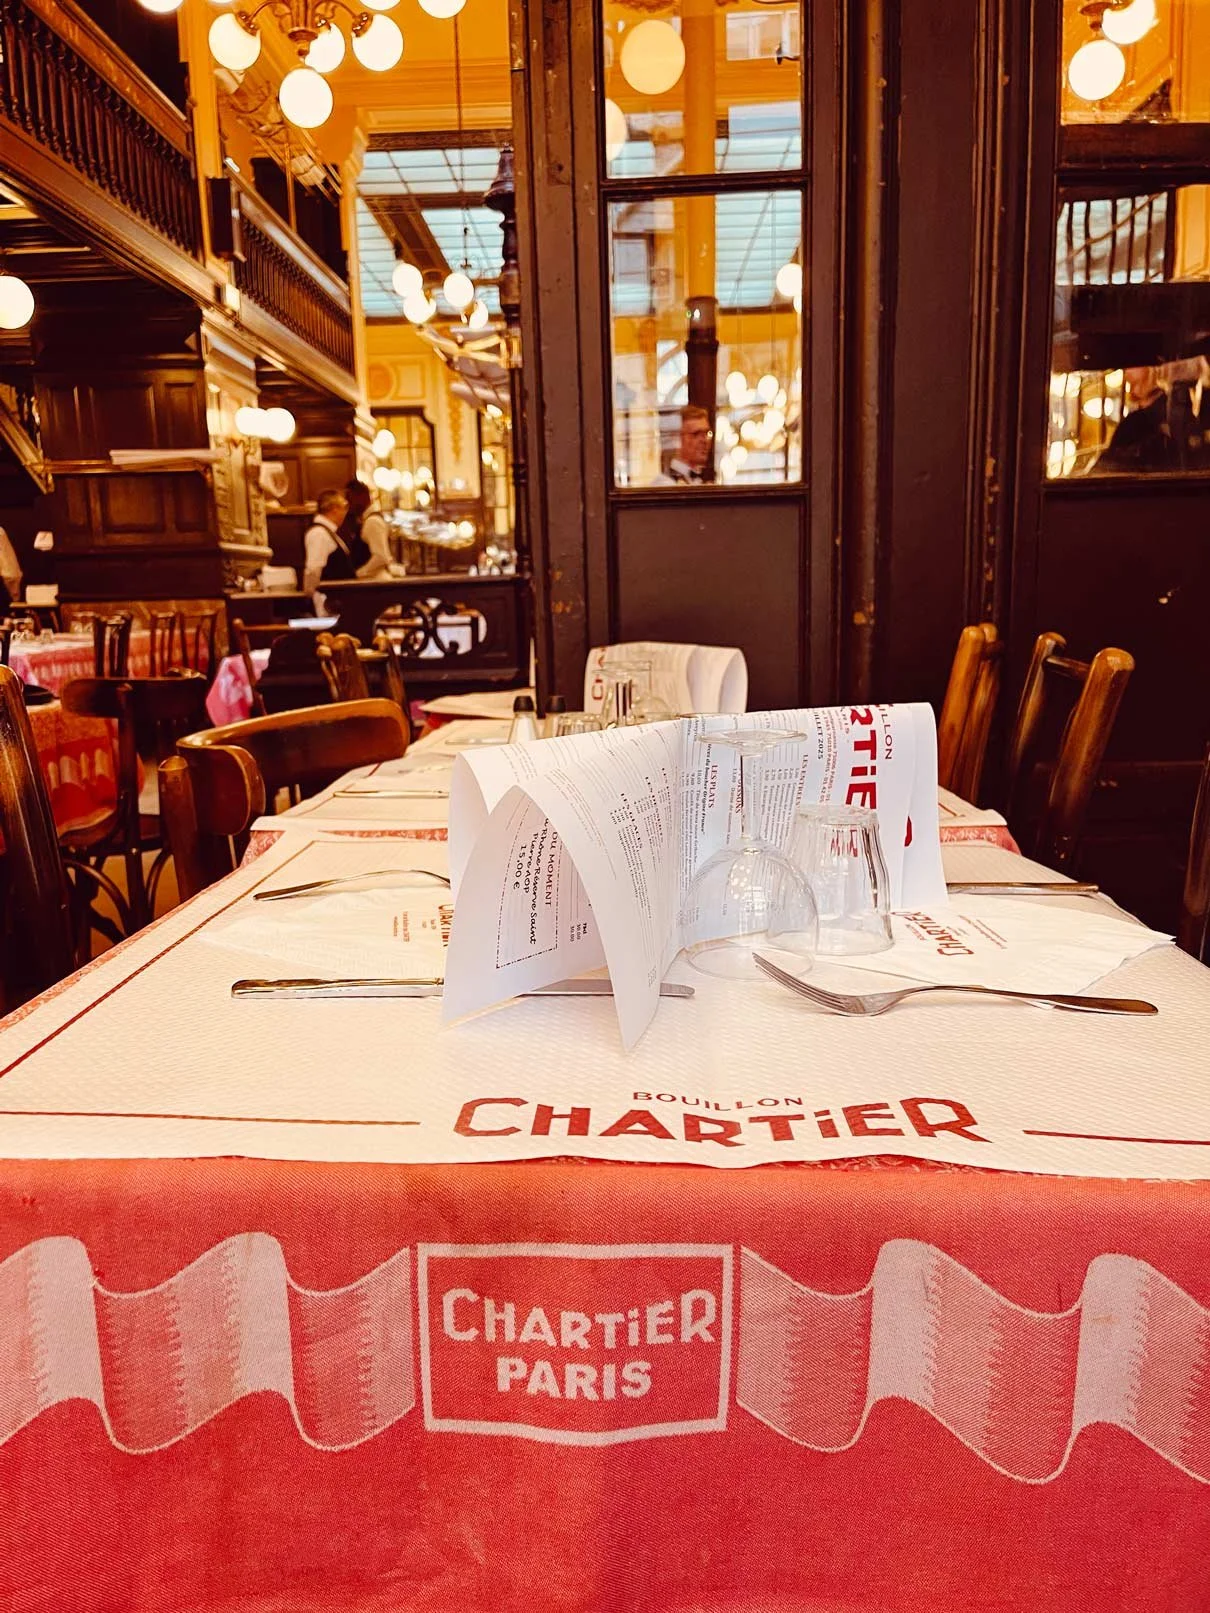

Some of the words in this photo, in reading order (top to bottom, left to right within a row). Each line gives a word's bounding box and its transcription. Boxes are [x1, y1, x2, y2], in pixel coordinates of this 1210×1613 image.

[710, 765, 718, 780] LES
[708, 781, 717, 809] PLATS
[526, 832, 539, 869] Pierre
[523, 870, 532, 894] AOP
[545, 854, 555, 907] MOMENT
[530, 912, 538, 945] Saint
[632, 1091, 804, 1112] BOUILLON
[496, 1356, 652, 1401] PARIS
